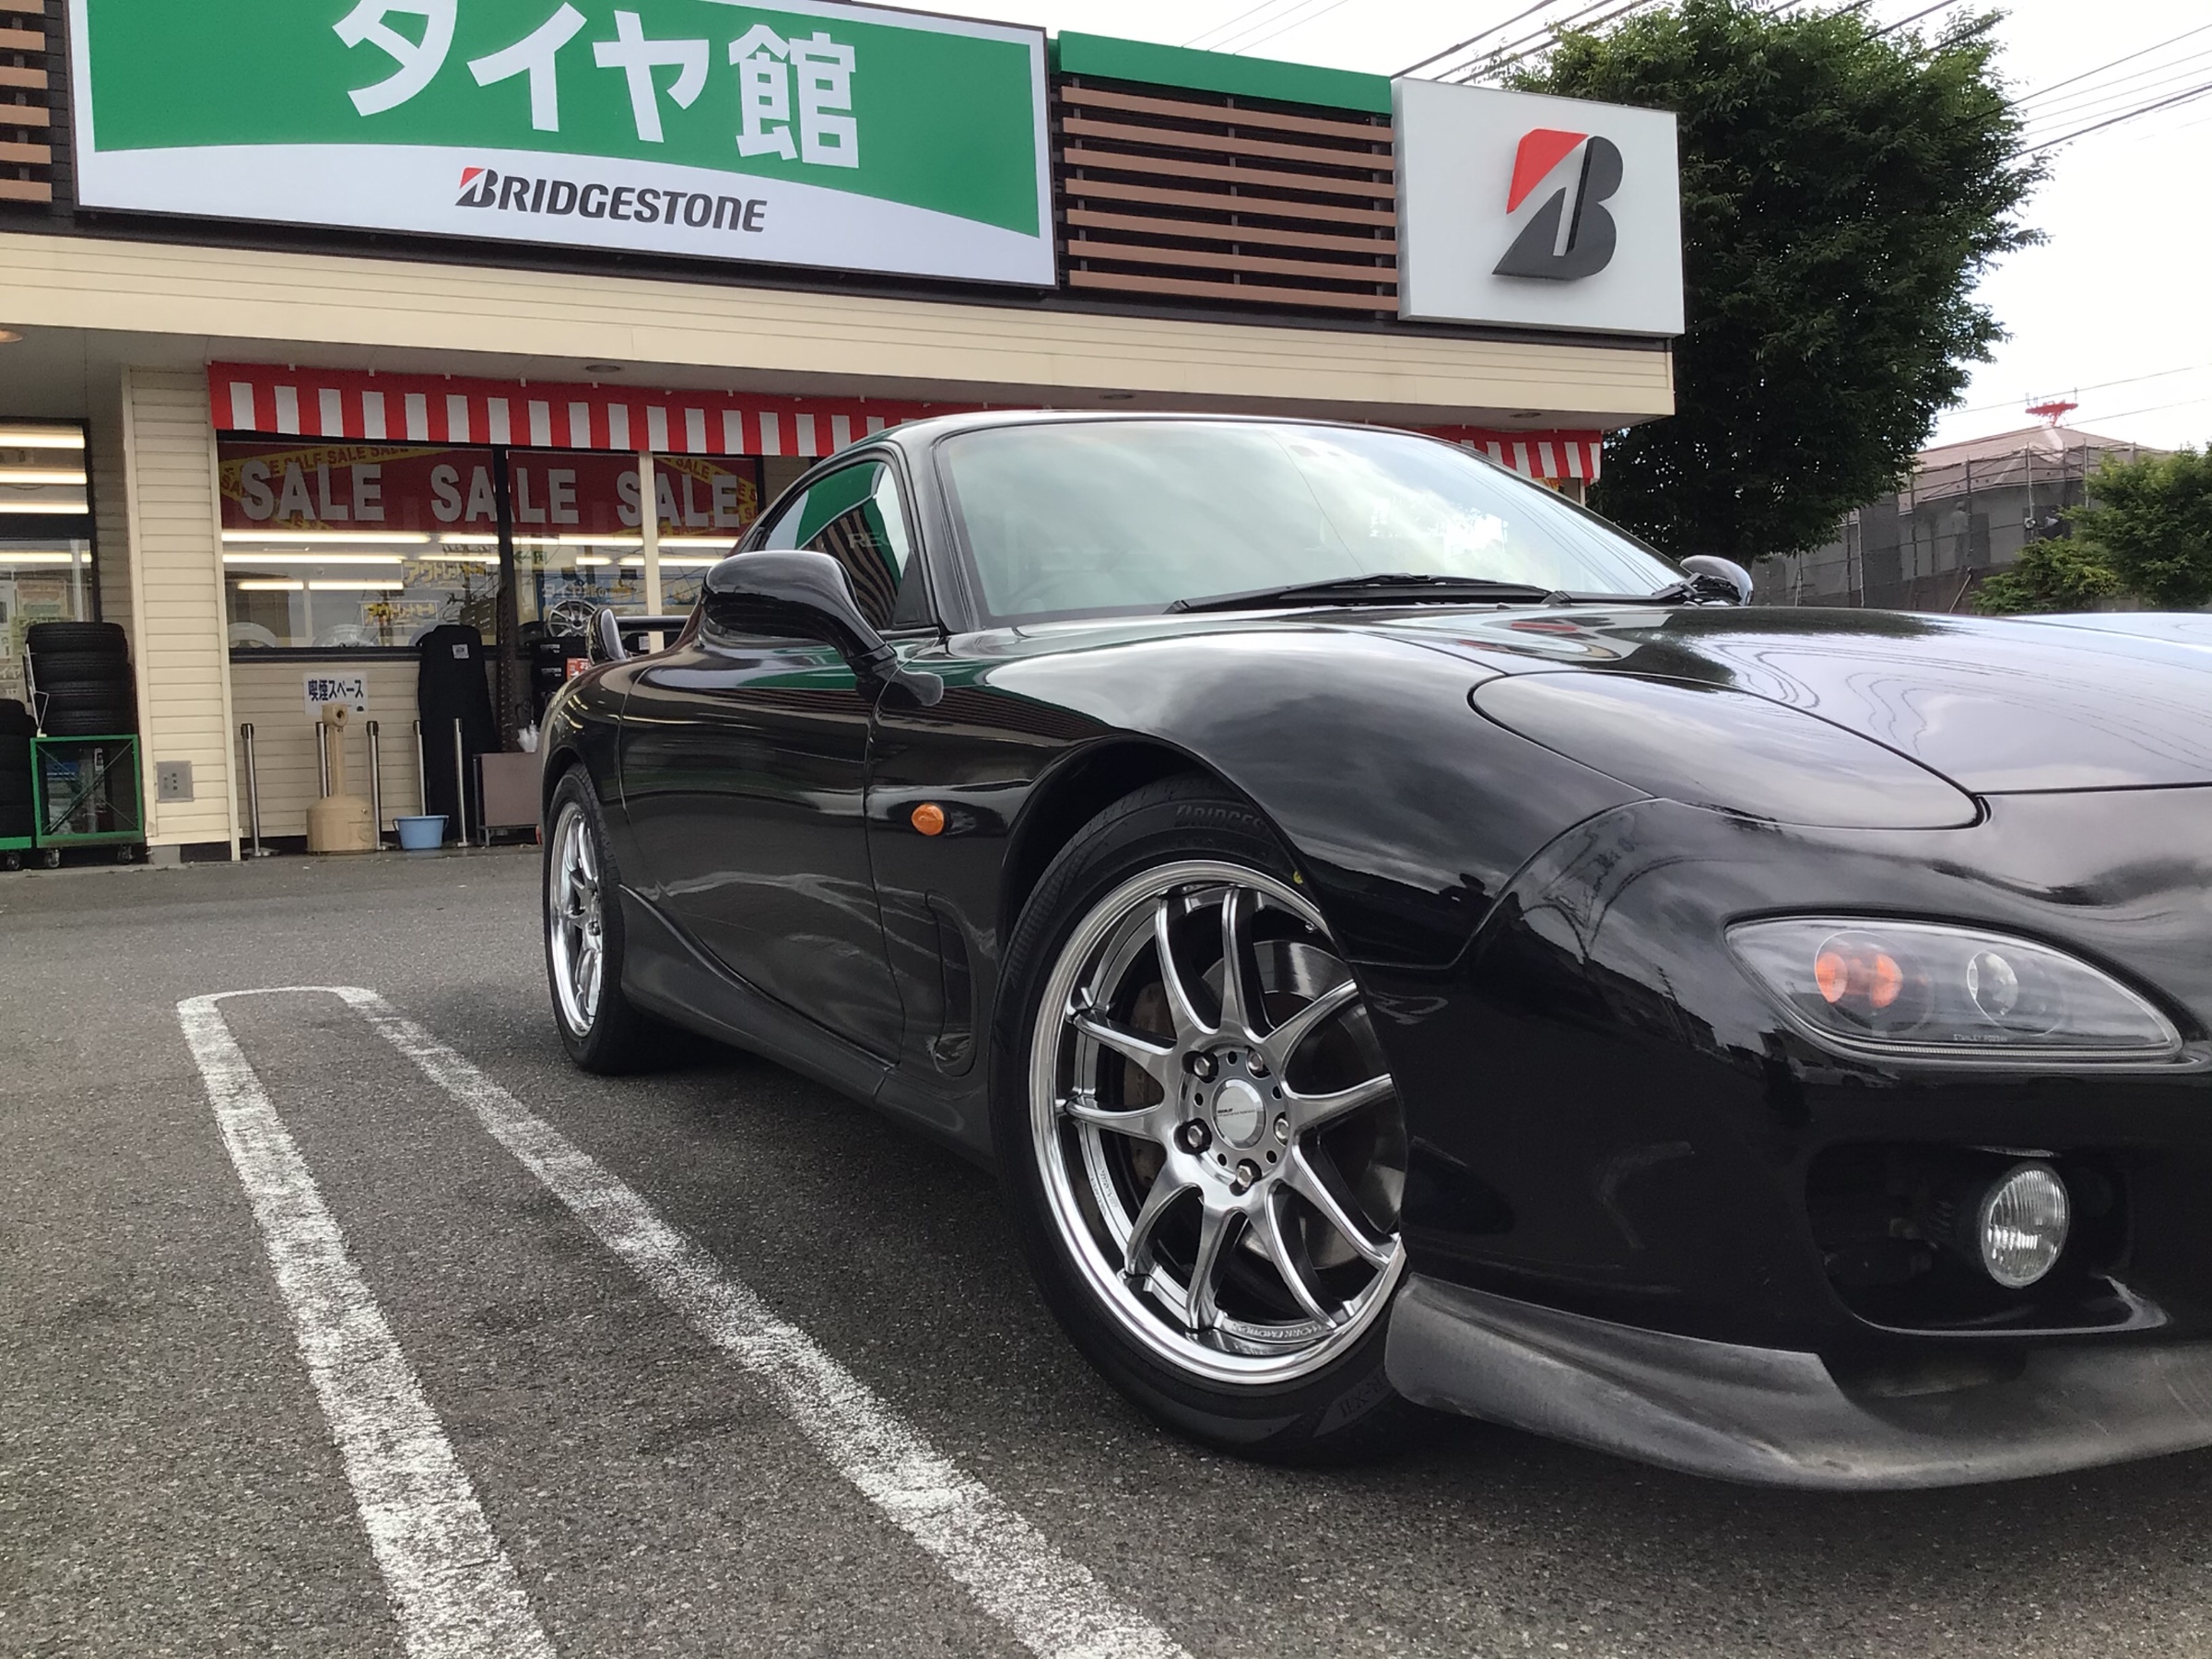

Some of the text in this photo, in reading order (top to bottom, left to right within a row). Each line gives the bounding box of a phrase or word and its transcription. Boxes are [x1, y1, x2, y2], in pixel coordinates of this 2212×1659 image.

[332, 0, 859, 169] タイヤ館
[455, 167, 768, 232] BRIDGESTONE
[327, 446, 367, 465] SALE
[676, 459, 710, 479] SALE
[241, 460, 740, 528] SALE SALE SALE
[308, 678, 364, 702] 喫煙スペース
